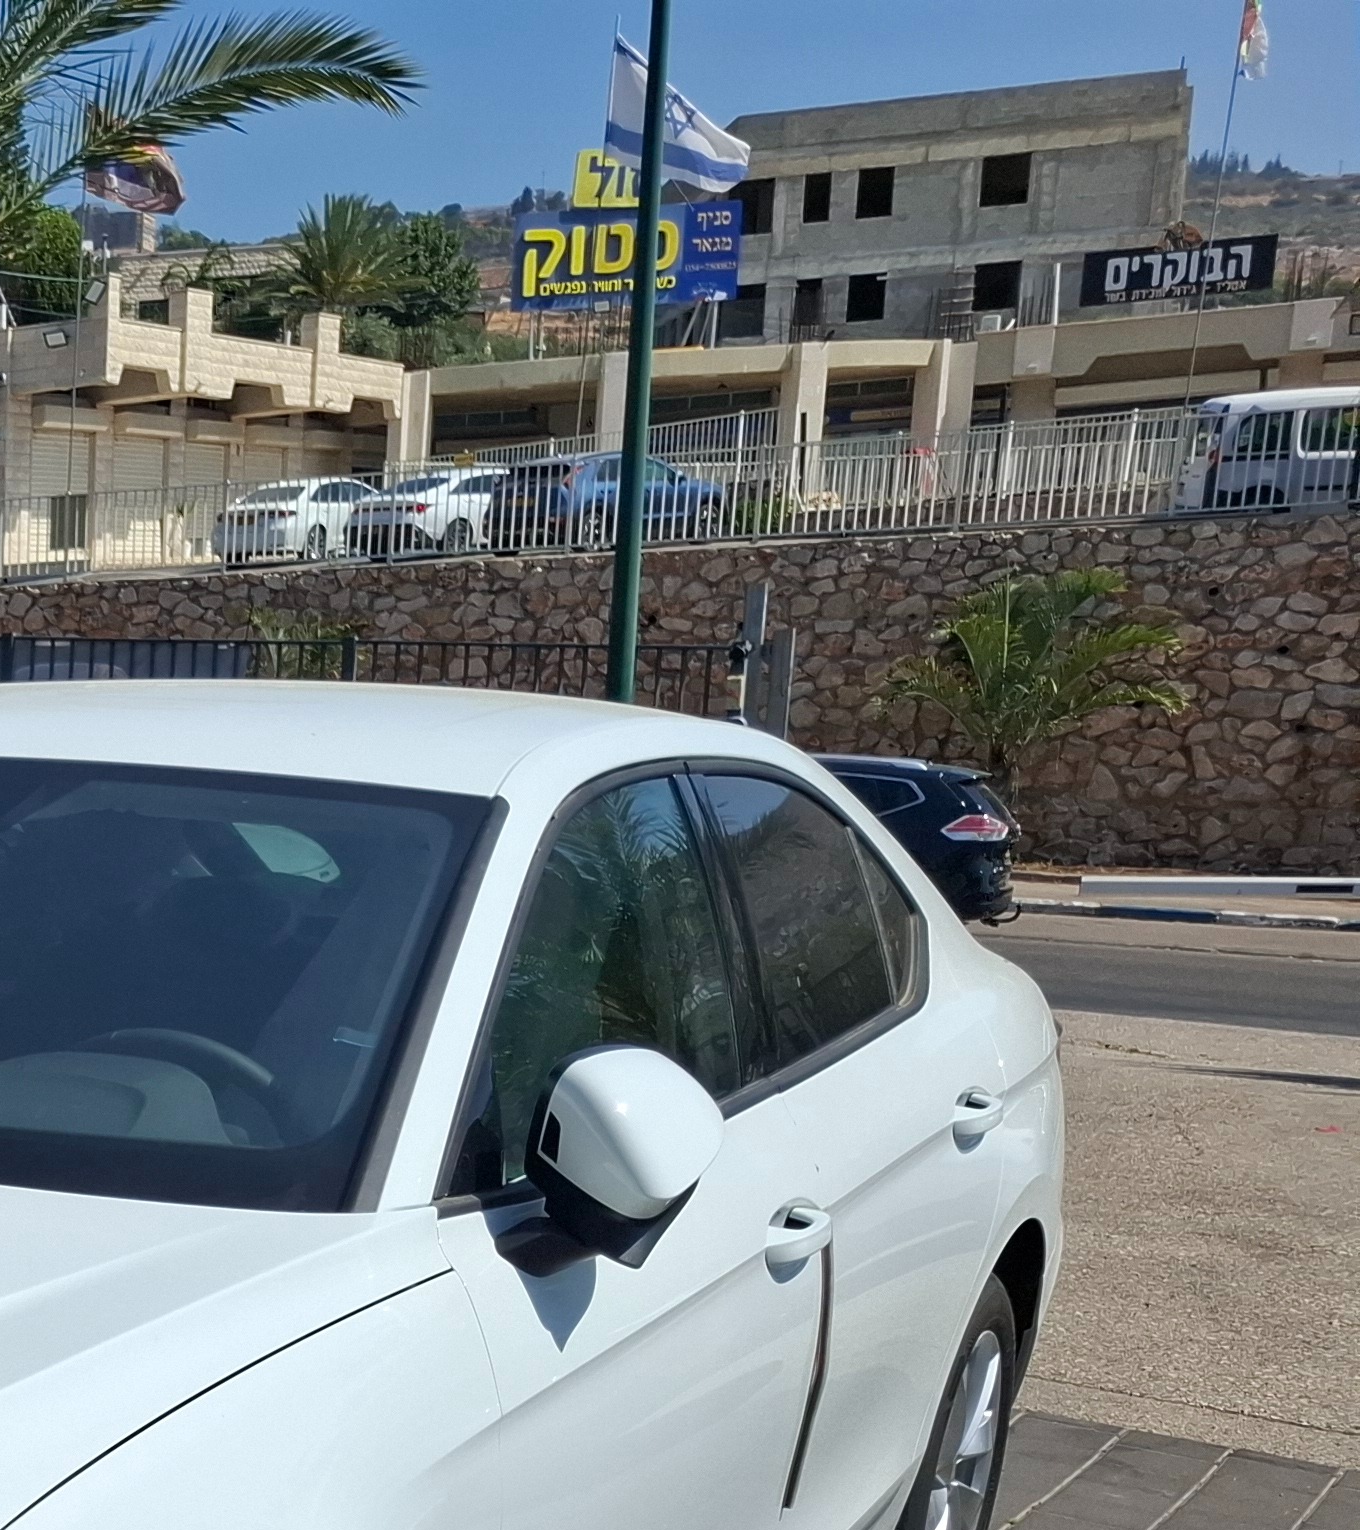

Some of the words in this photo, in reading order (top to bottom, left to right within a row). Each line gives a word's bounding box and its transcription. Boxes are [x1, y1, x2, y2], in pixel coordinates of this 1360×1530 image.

[697, 211, 732, 232] סניף
[692, 236, 733, 253] מגאר
[1105, 245, 1252, 292] הבוקרים
[540, 280, 586, 296] נפגשים
[1104, 292, 1126, 303] בשר
